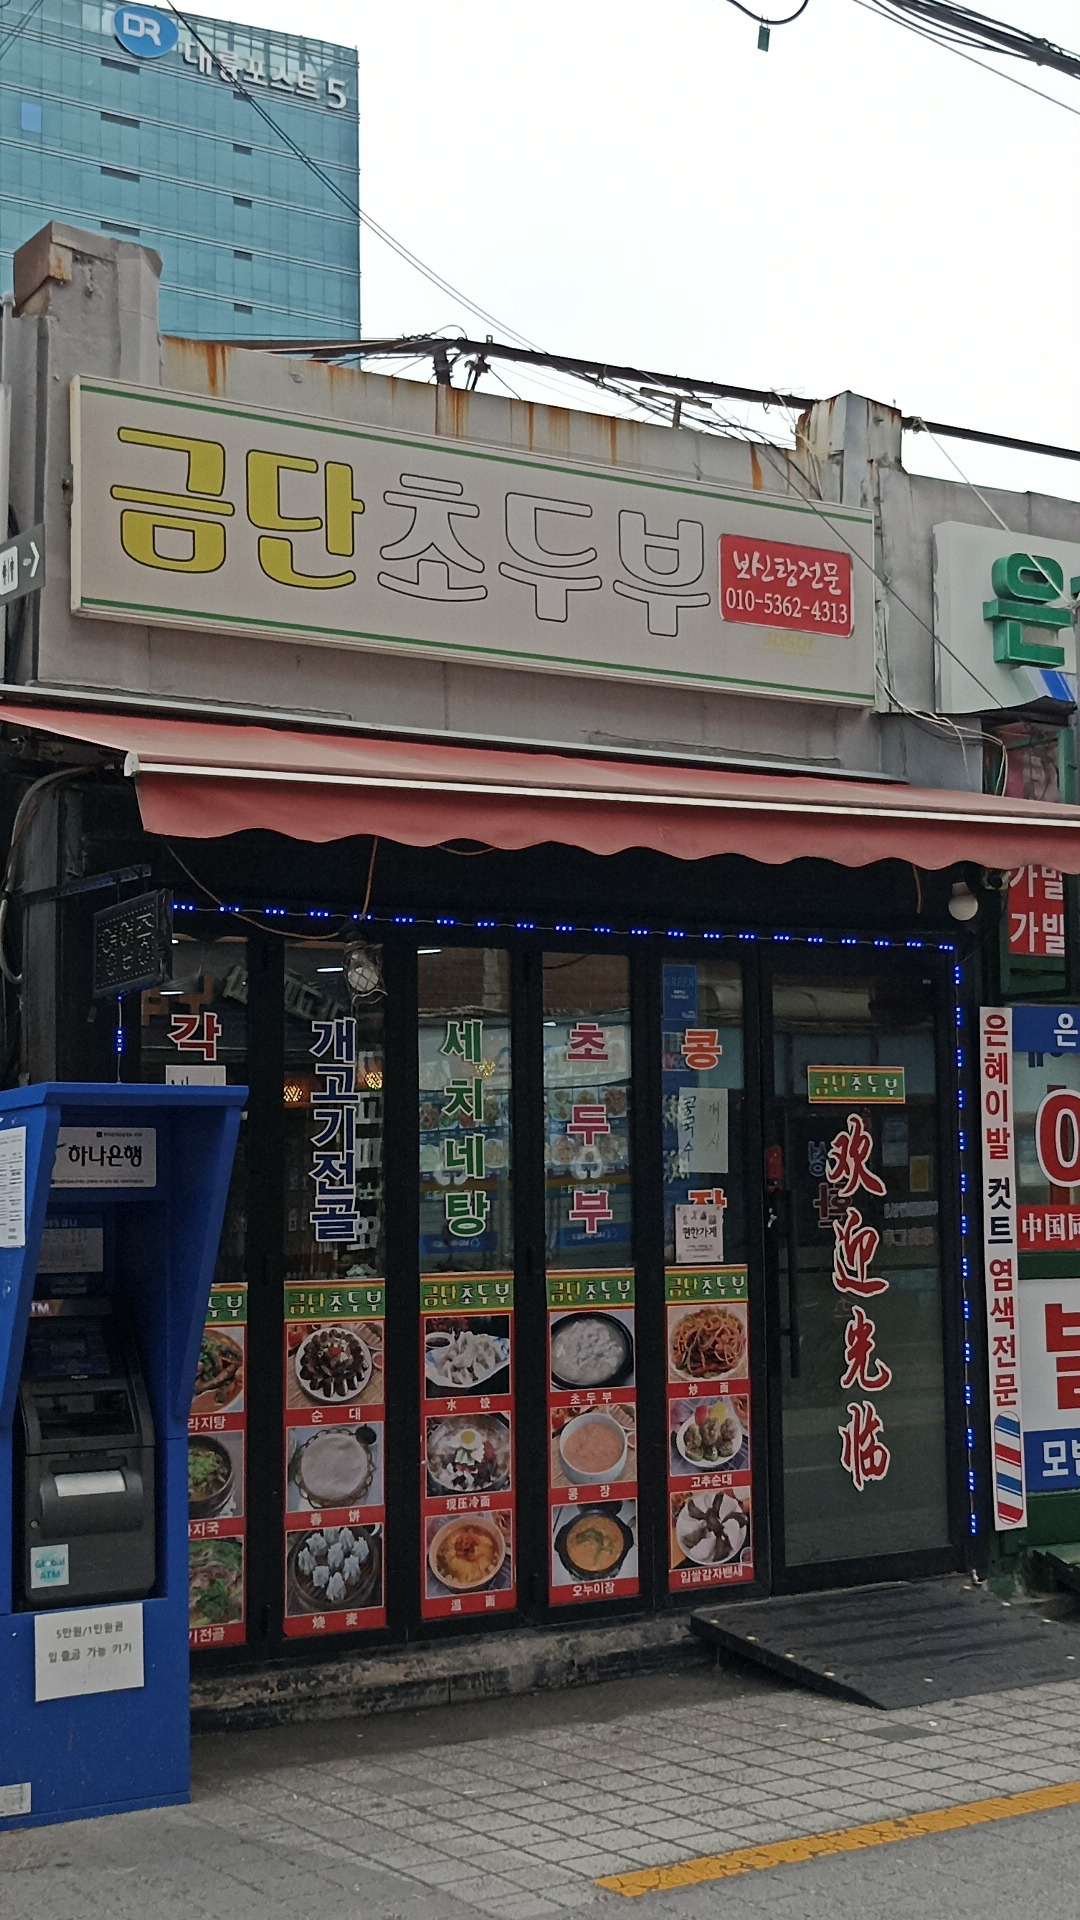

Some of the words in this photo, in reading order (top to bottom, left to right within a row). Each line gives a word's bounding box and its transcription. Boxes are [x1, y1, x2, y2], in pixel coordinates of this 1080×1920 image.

[122, 13, 162, 47] DR
[326, 79, 347, 110] 5
[110, 426, 711, 638] 금단초두부
[725, 587, 848, 624] 010-5362-4313
[167, 1012, 222, 1061] 각
[984, 1014, 1011, 1160] 은혜이발
[68, 1145, 142, 1167] 하나은행
[309, 1016, 360, 1242] 개고기전골
[440, 1018, 490, 1237] 세치네탕
[988, 1177, 1013, 1244] 컷트
[989, 1258, 1018, 1407] 염색전문
[691, 1474, 732, 1488] 고추순대
